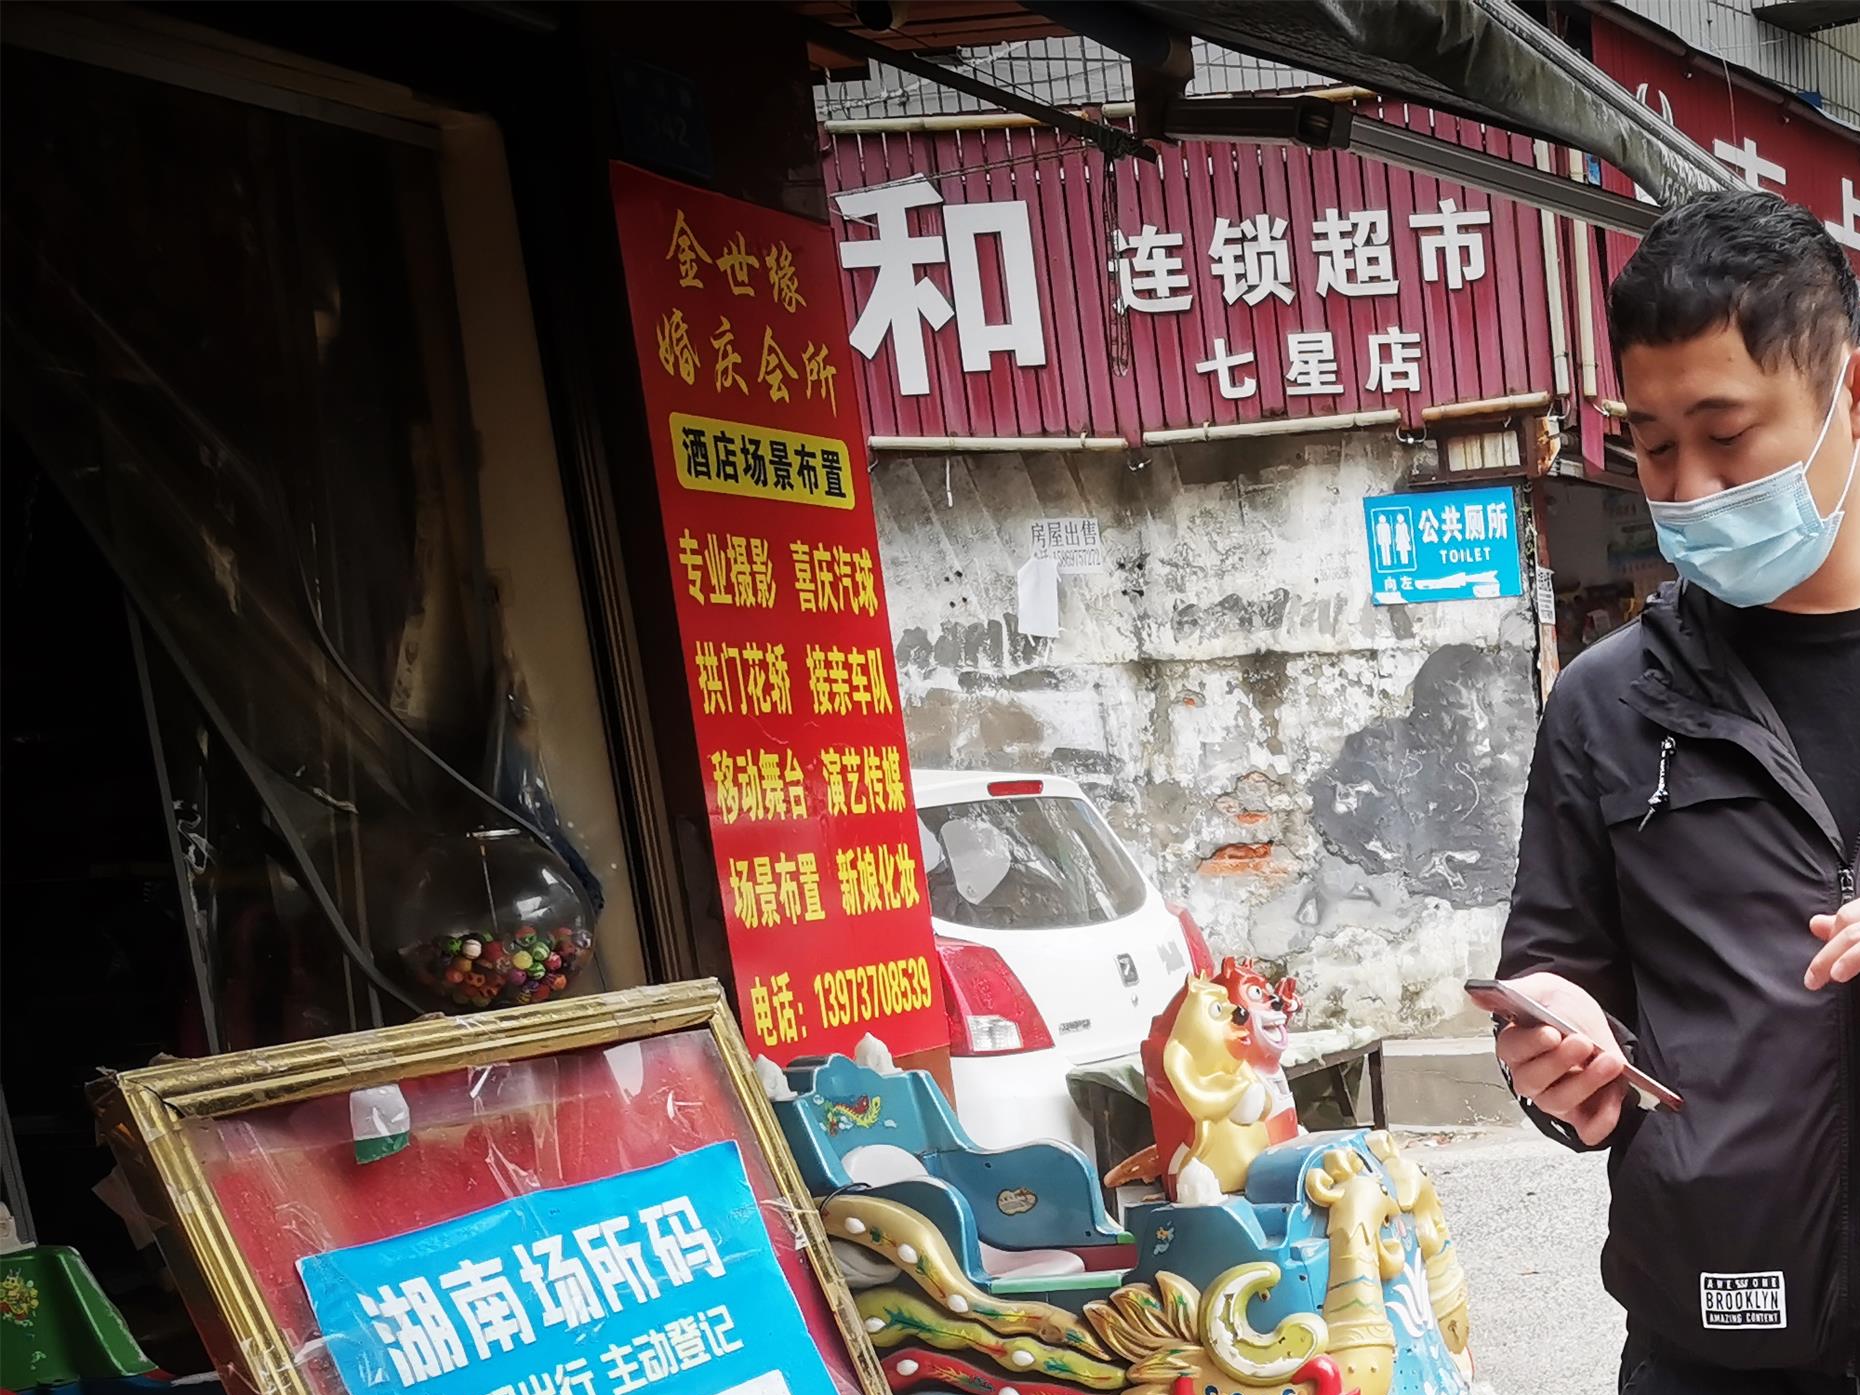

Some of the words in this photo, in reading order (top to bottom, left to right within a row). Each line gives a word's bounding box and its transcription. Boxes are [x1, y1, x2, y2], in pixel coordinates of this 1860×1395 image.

[834, 172, 1047, 396] 和
[1112, 198, 1491, 314] 连锁超市
[1195, 325, 1422, 400] 七星店
[681, 425, 849, 500] 酒店场景布置
[1030, 519, 1098, 549] 房屋出售
[1417, 501, 1509, 545] 公共厕所
[1439, 547, 1492, 565] TOILET
[678, 527, 777, 609] 专业摄影
[788, 540, 880, 619] 喜庆汽球
[1383, 575, 1415, 593] 向左
[694, 641, 793, 717] 拱门花轿
[804, 644, 894, 717] 接亲车队
[710, 748, 808, 825] 移动舞台
[819, 745, 907, 817] 演艺传媒
[728, 850, 826, 929] 场景布置
[835, 842, 921, 916] 新娘化妆
[358, 1195, 728, 1388] 湖南场所码
[1706, 1291, 1779, 1310] BROOKLYN
